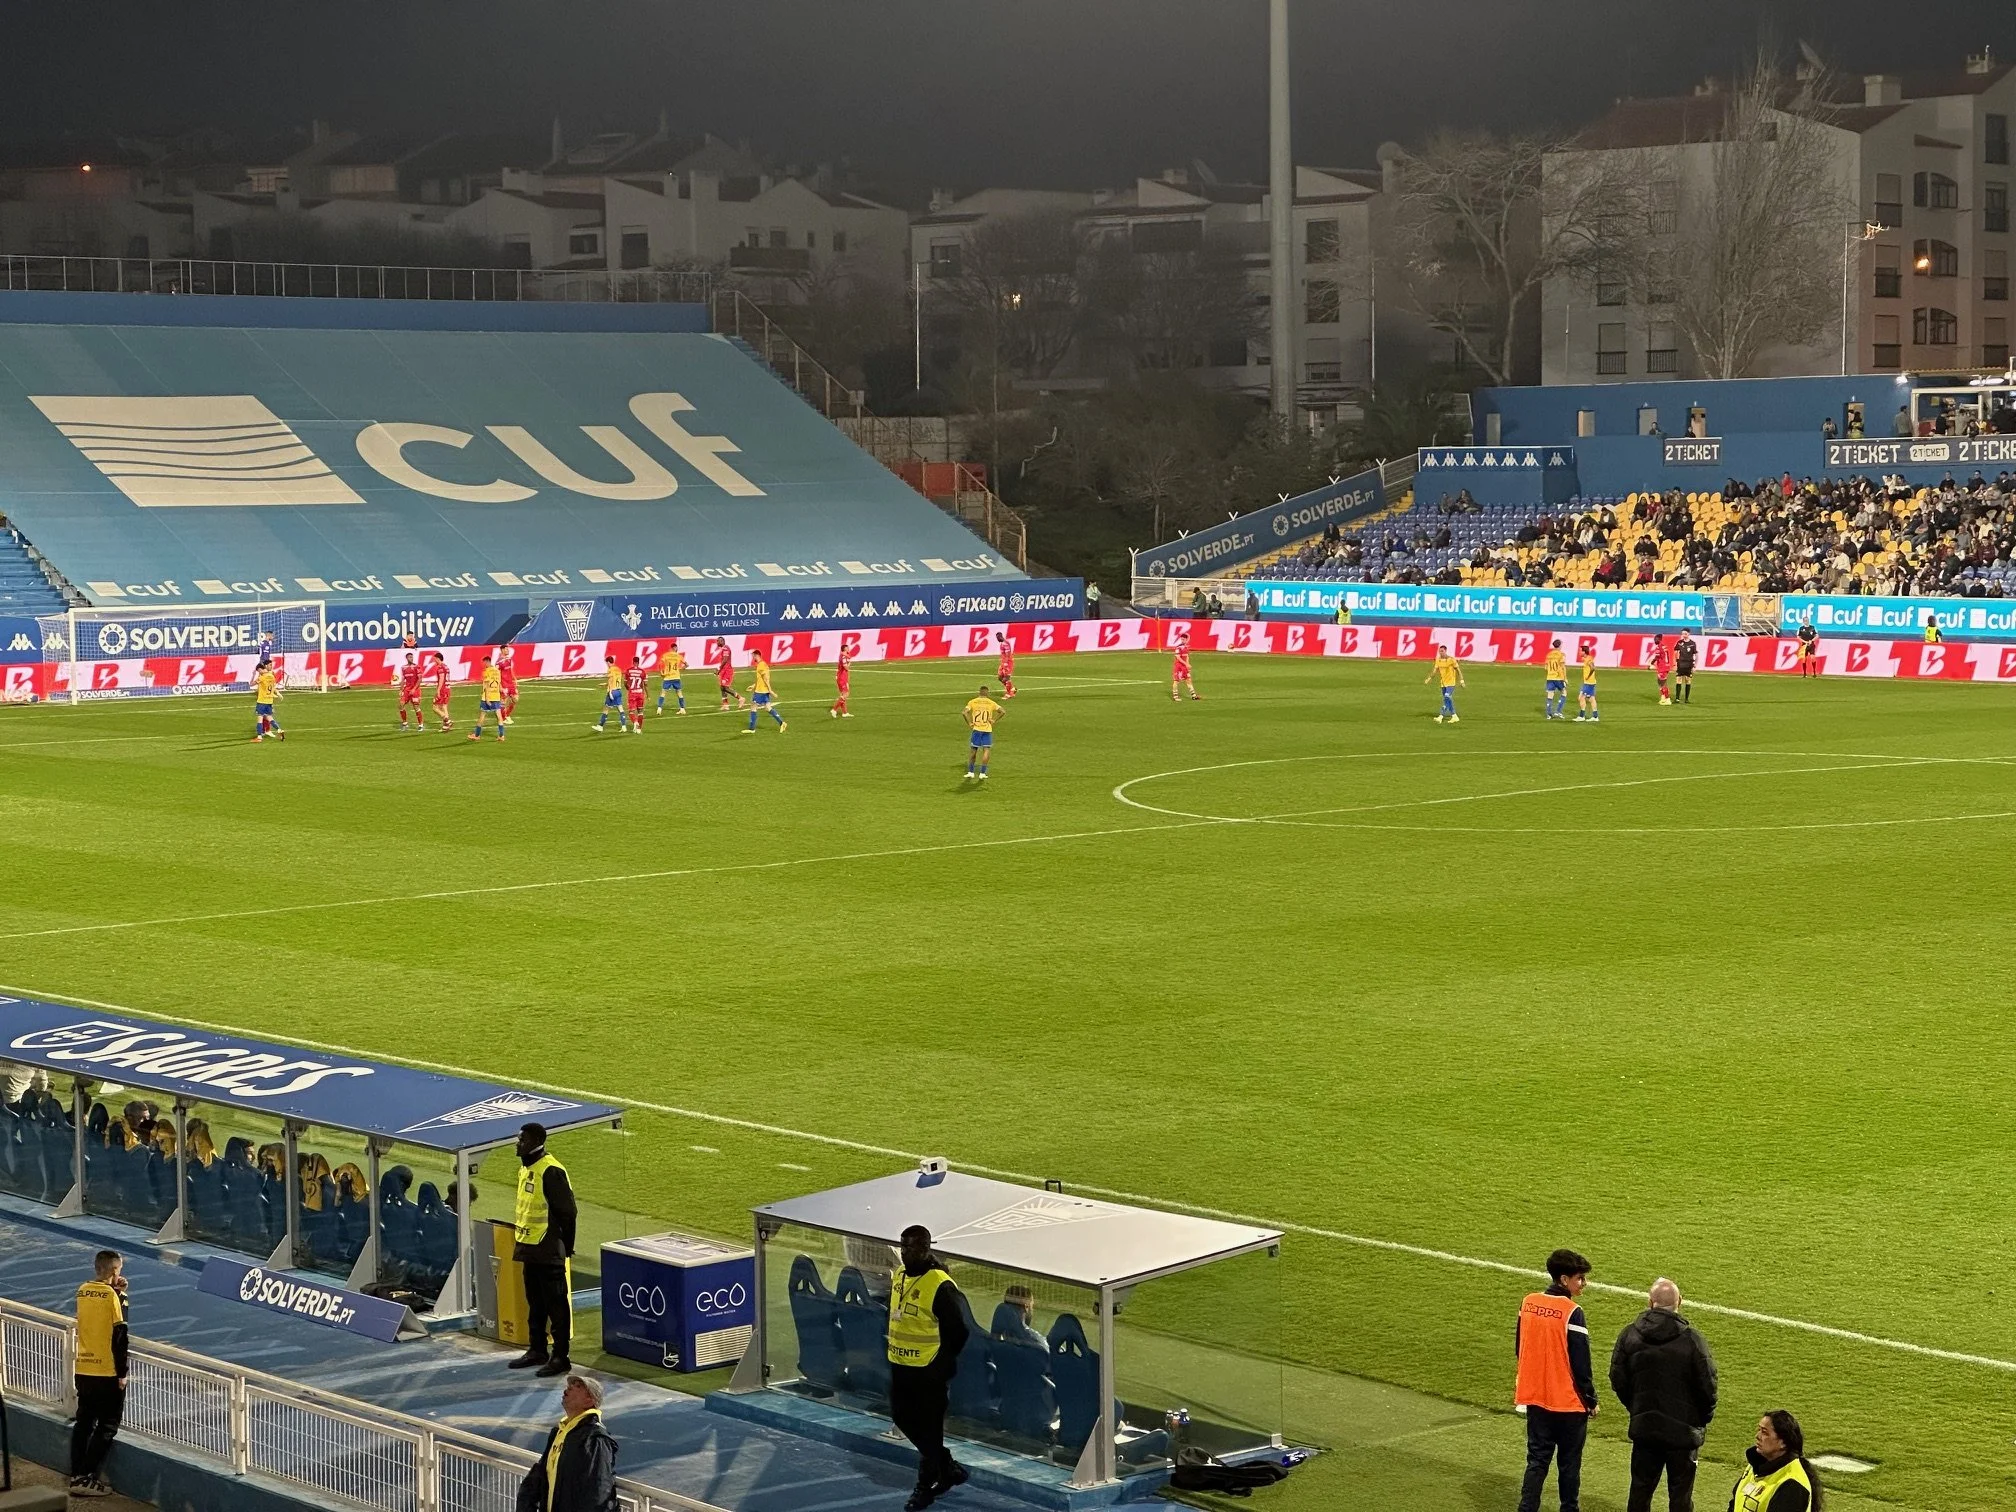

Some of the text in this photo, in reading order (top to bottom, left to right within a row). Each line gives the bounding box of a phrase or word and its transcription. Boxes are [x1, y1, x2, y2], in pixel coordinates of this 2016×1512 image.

[356, 393, 767, 502] cuf
[1959, 440, 2016, 461] 2TICKE
[1291, 490, 1375, 528] SOLVERDE.PT
[1168, 533, 1254, 574] SOLVERDE.PT
[126, 554, 997, 597] cuf cuf cuf cuf cuf cuf cuf cuf cuf cuf
[650, 602, 769, 619] PALÁCIO ESTORIL
[957, 596, 1005, 612] FIX&GO
[1026, 593, 1074, 610] FIX&GO
[1284, 589, 1306, 608] cuf
[1359, 591, 1382, 610] cuf
[1397, 592, 1421, 611] cuf
[1437, 594, 1461, 613] cuf
[1470, 594, 1495, 614] cuf
[1512, 596, 1537, 616] cuf
[1554, 597, 1579, 617] cuf
[1597, 598, 1623, 618] cuf
[1640, 600, 1667, 619] cuf
[1686, 605, 1703, 620] cu
[690, 620, 709, 629] GOLF
[713, 620, 718, 628] &
[721, 618, 760, 628] WELLNESS
[1834, 604, 1864, 626] cuf
[1884, 606, 1914, 627] cuf
[1936, 607, 1967, 628] cuf
[130, 626, 268, 650] SOLVERDE.P
[46, 1033, 375, 1097] SAGRES
[257, 1277, 355, 1325] SOLVERDE.PT
[696, 1282, 746, 1312] eco
[1524, 1303, 1563, 1319] Kappa
